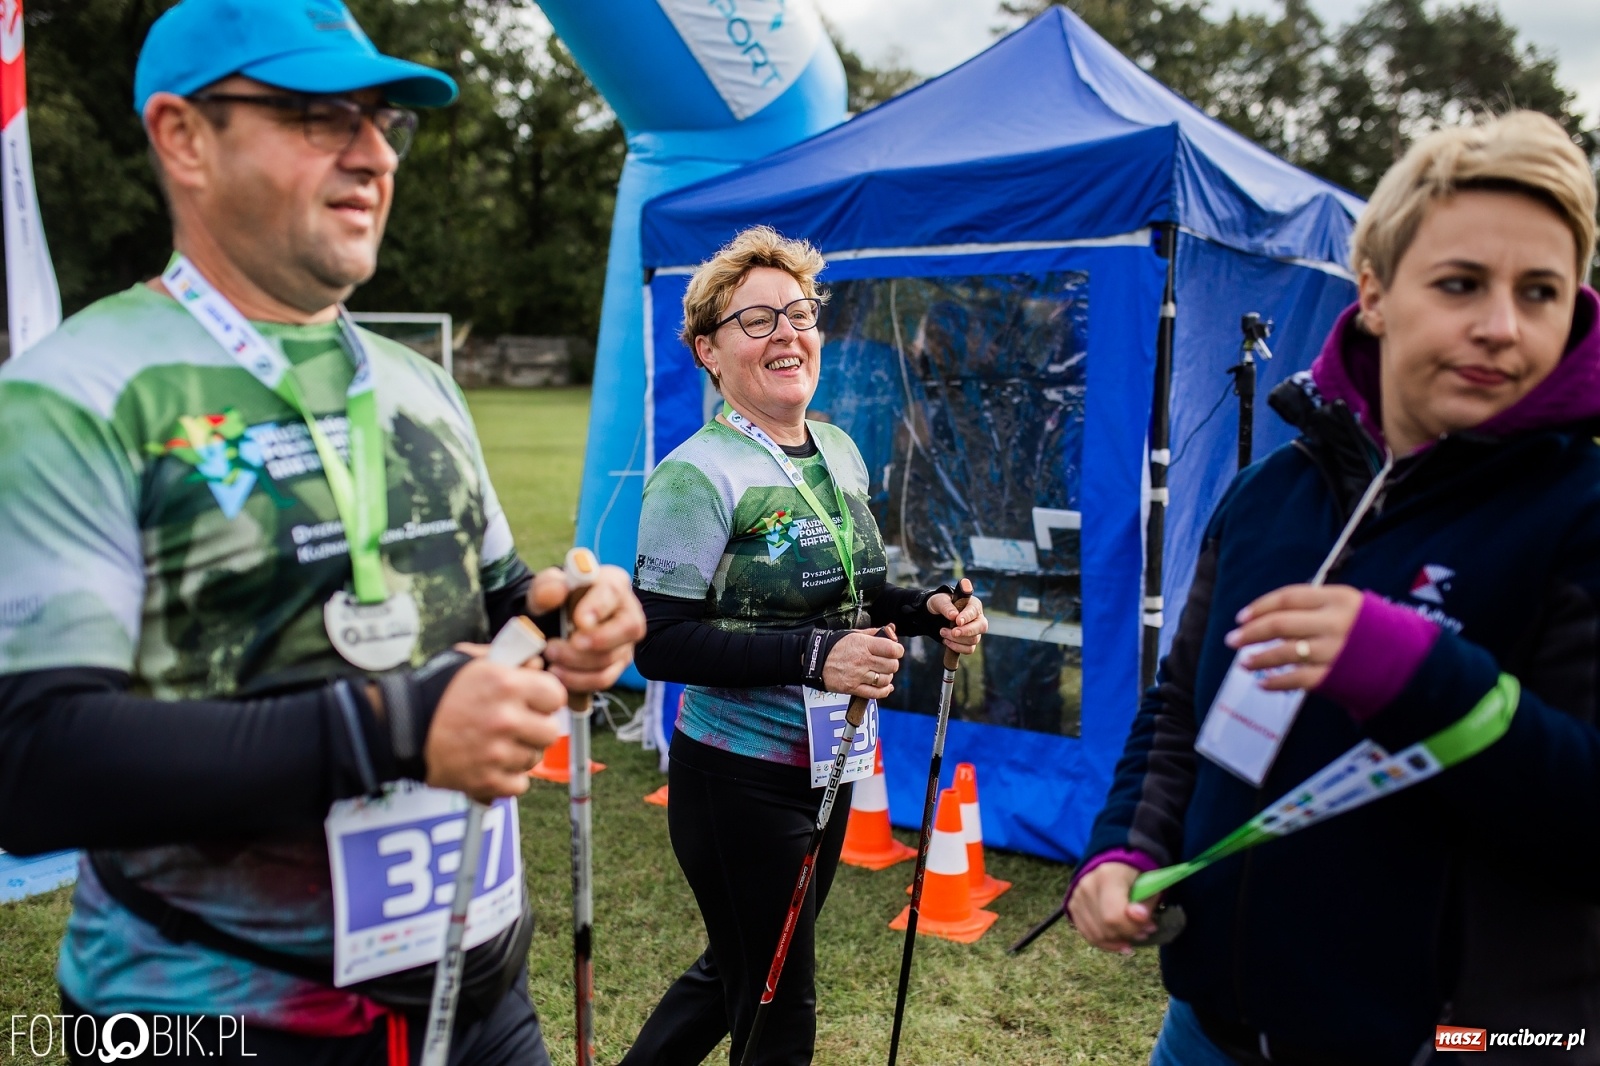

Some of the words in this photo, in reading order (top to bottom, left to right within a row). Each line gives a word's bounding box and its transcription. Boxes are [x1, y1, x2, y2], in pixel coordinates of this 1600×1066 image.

[647, 556, 676, 570] MACHIKO
[802, 569, 831, 579] DYSZKA
[829, 703, 876, 755] 336
[822, 753, 846, 808] GABEL
